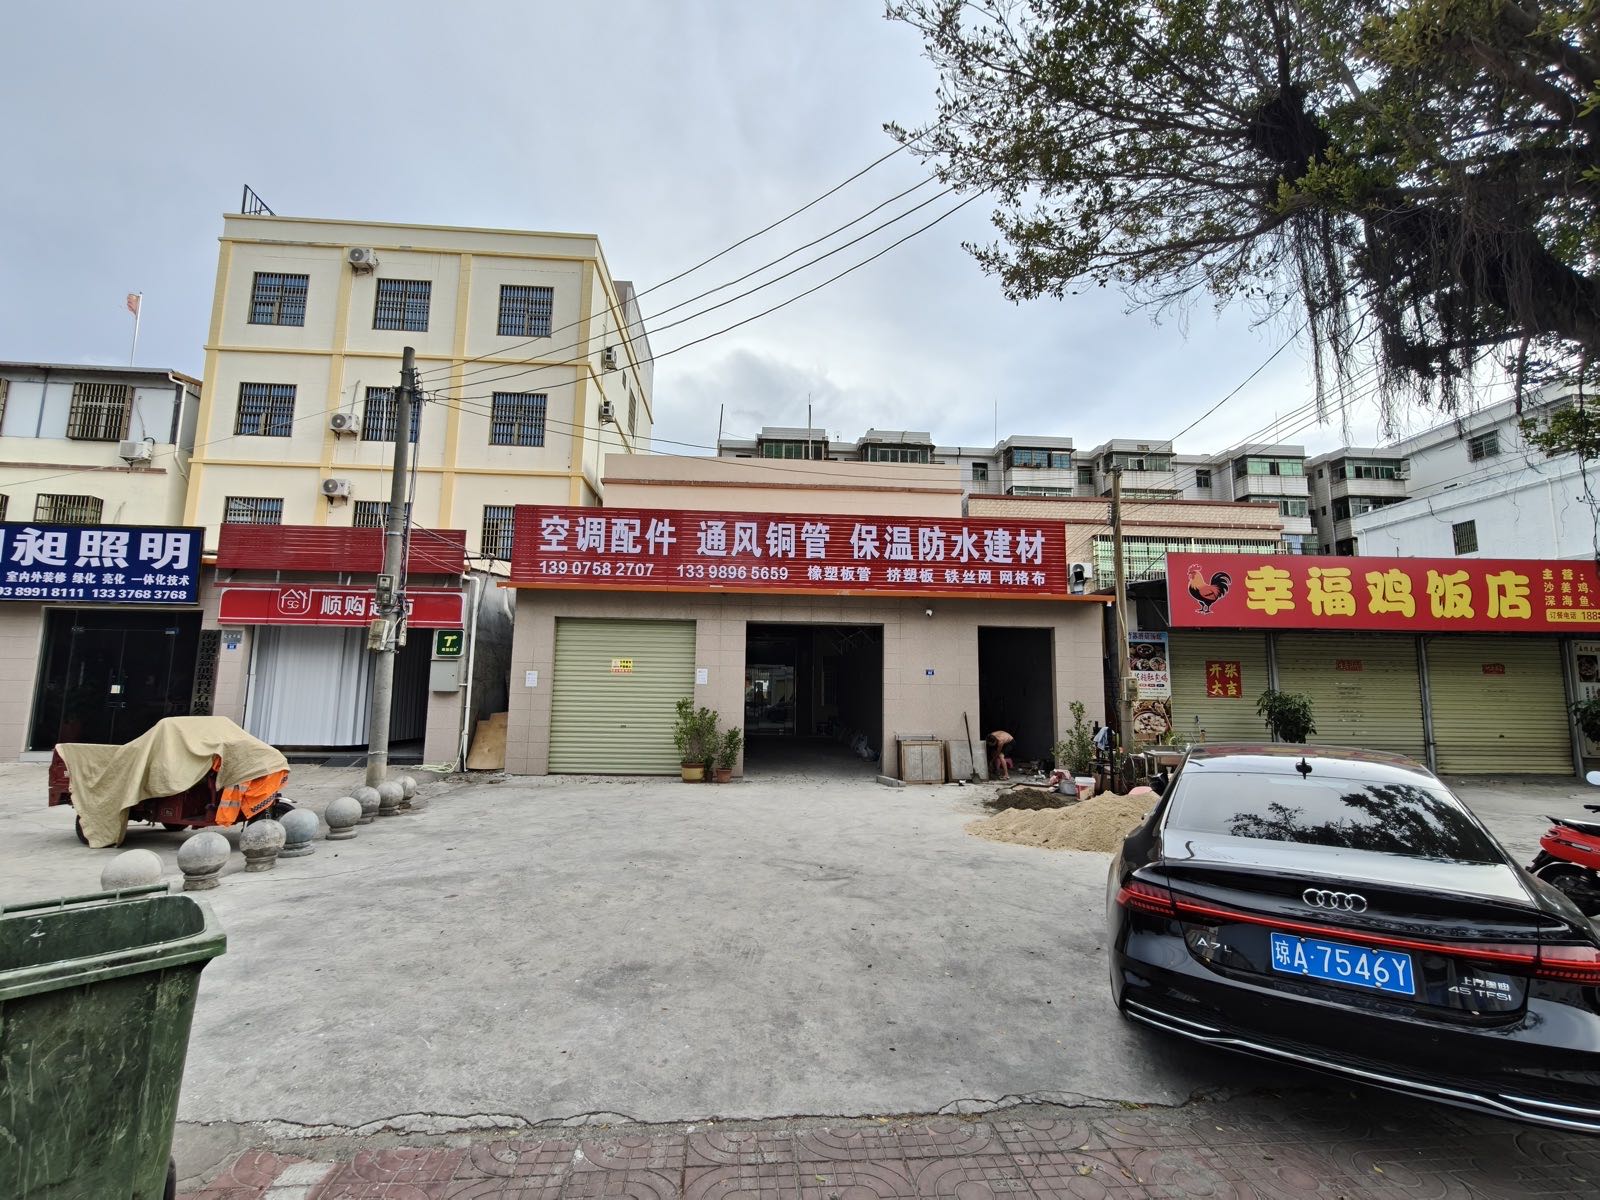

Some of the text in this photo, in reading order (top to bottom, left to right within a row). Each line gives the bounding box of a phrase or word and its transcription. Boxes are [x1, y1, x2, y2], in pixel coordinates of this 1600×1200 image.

[0, 527, 191, 570] 昶照明
[540, 515, 1046, 565] 空调配件 通风铜管 保温防水建材
[6, 571, 67, 583] 室内外装修
[72, 572, 96, 584] 绿化
[131, 575, 189, 586] 一体化技术
[539, 560, 567, 575] 139
[572, 561, 612, 576] 0758
[616, 562, 654, 577] 2707
[676, 565, 704, 578] 133
[708, 564, 747, 579] 9896
[751, 566, 788, 580] 5659
[807, 565, 871, 582] 橡塑板管
[944, 569, 992, 584] 铁丝网
[1000, 571, 1046, 586] 网格布
[15, 587, 47, 597] 8991
[51, 587, 84, 598] 8111
[92, 588, 116, 598] 133
[118, 589, 152, 600] 3768
[154, 590, 187, 600] 3768
[1245, 565, 1532, 619] 幸福鸡饭店
[320, 594, 415, 617] 顺购
[1209, 663, 1239, 679] 开张
[1209, 680, 1238, 696] 大吉
[1448, 985, 1512, 1002] 45 TFSI
